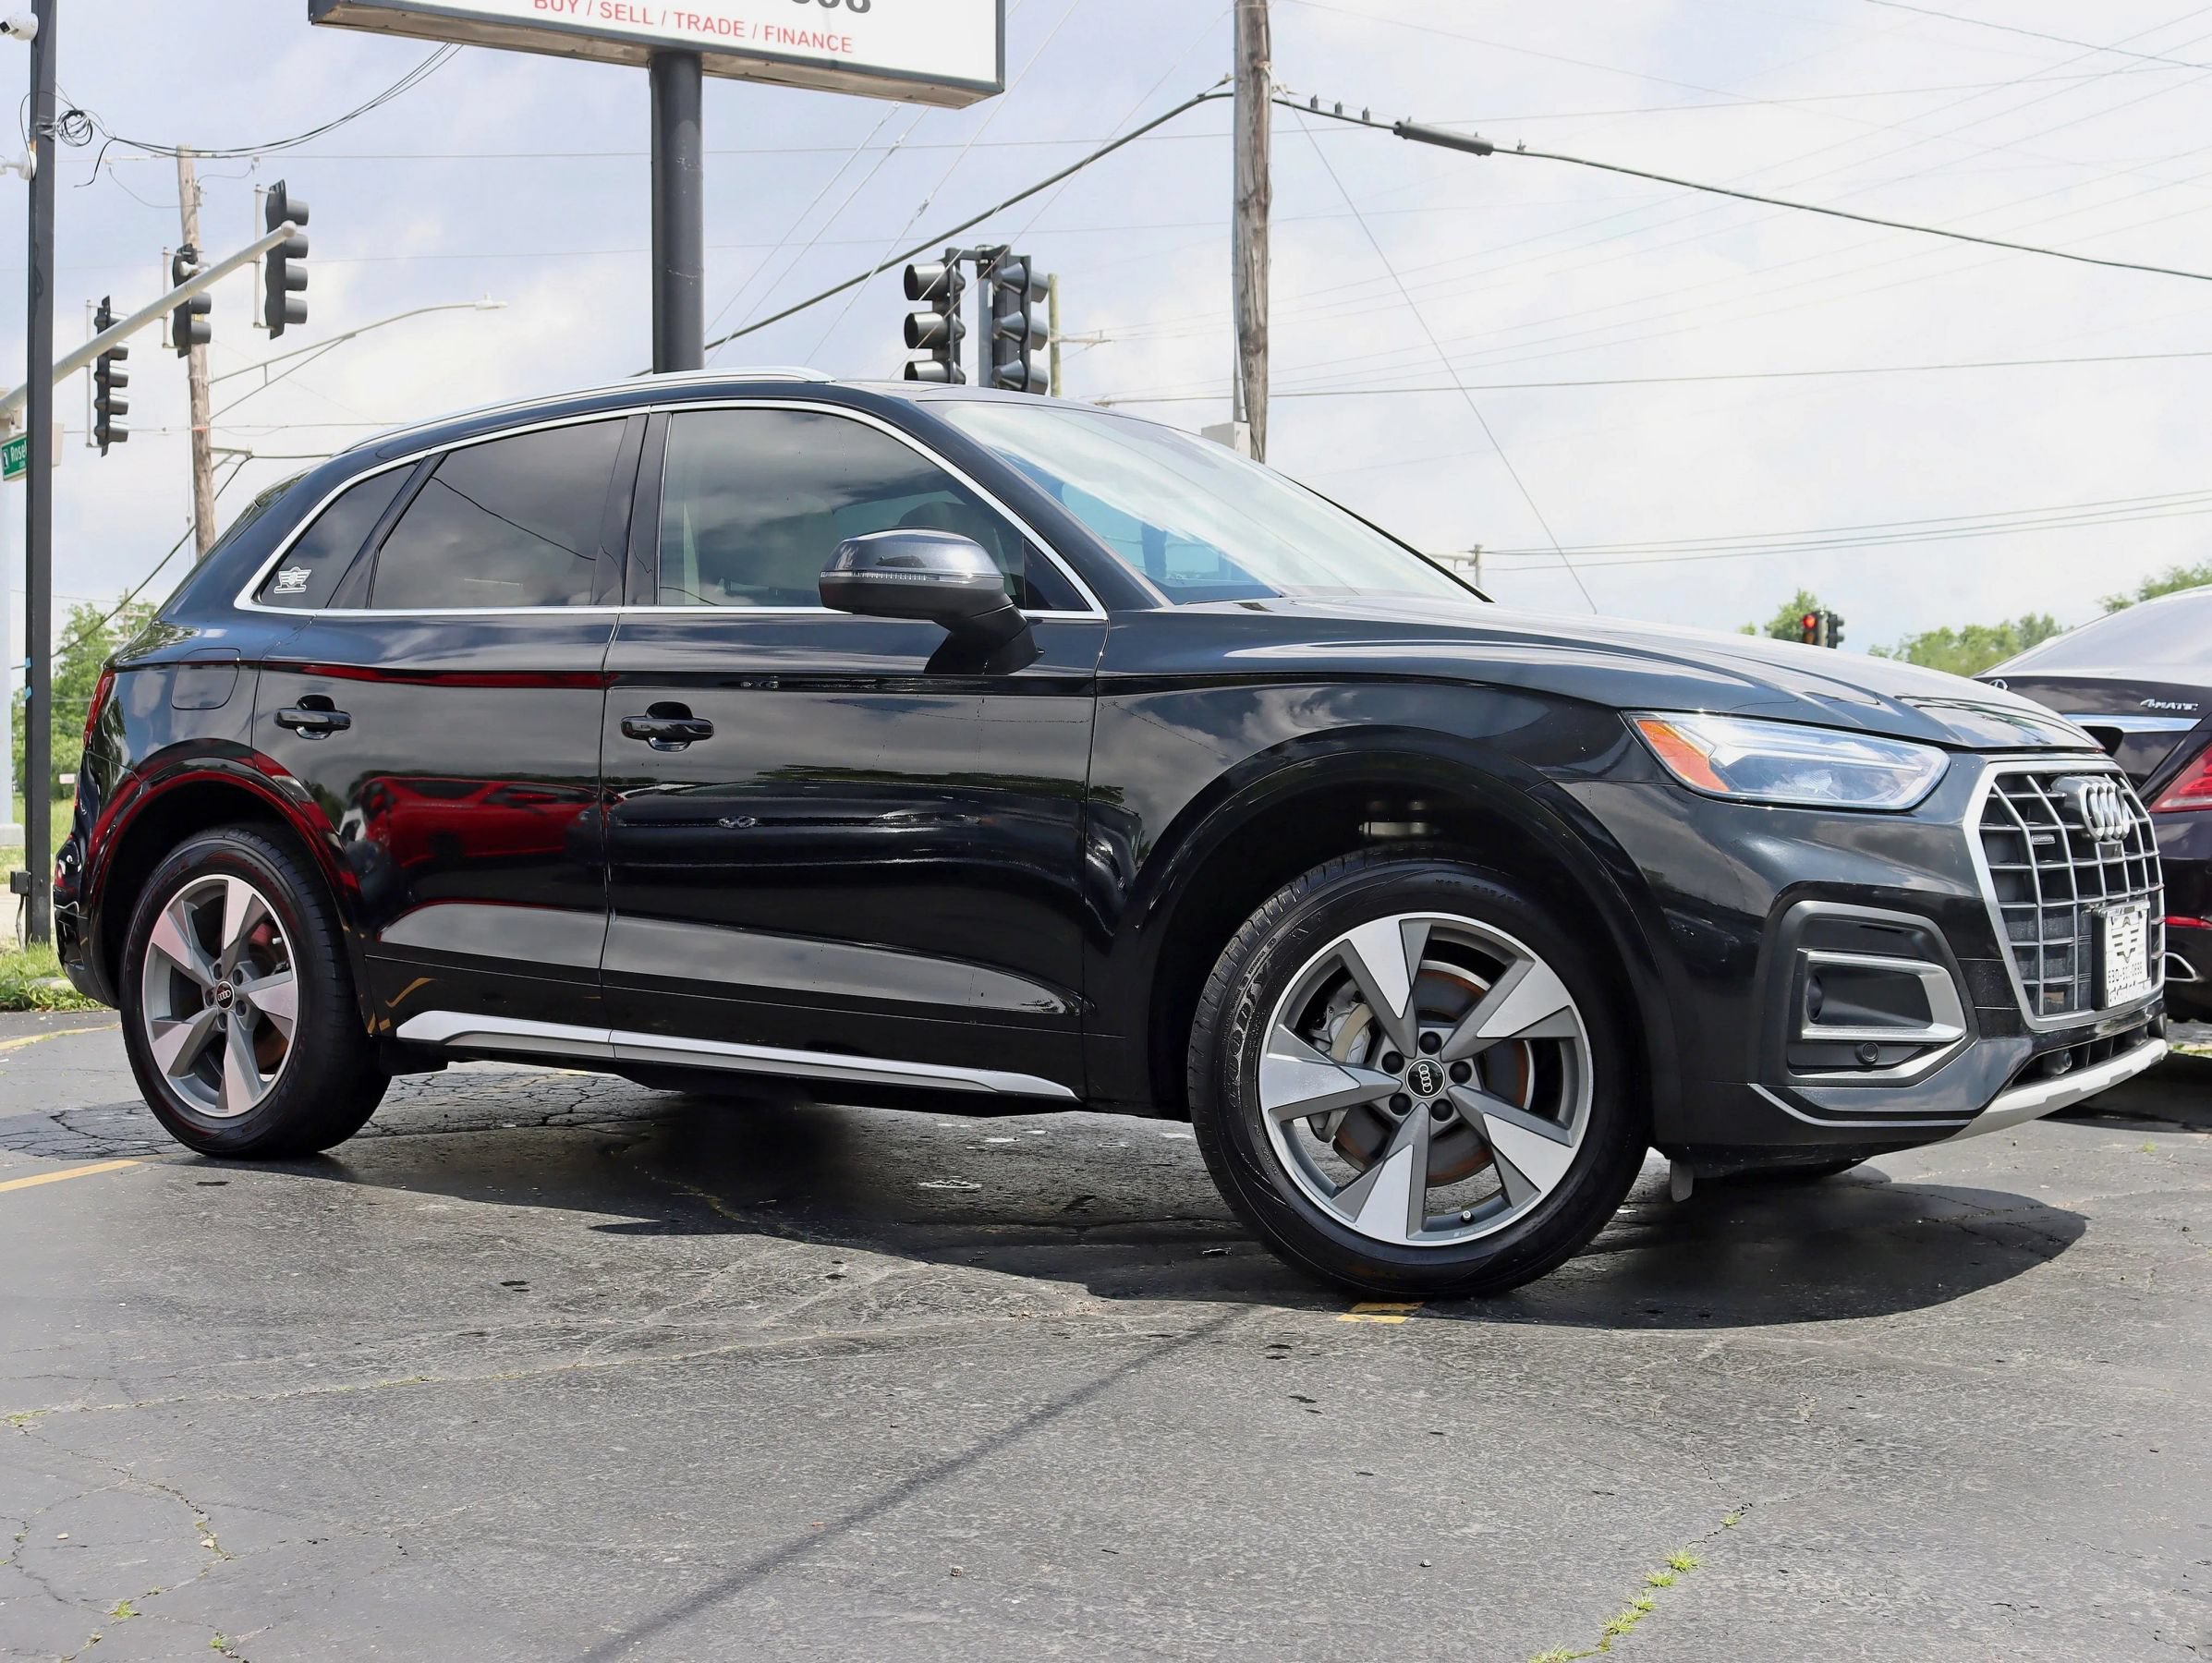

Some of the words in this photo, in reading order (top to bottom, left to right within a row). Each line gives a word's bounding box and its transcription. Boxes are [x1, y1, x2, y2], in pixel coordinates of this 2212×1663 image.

[534, 0, 579, 14] BUY
[600, 2, 654, 25] SELL
[661, 10, 667, 27] /
[674, 12, 746, 38] TRADE
[751, 23, 758, 40] /
[764, 25, 854, 54] FINANCE
